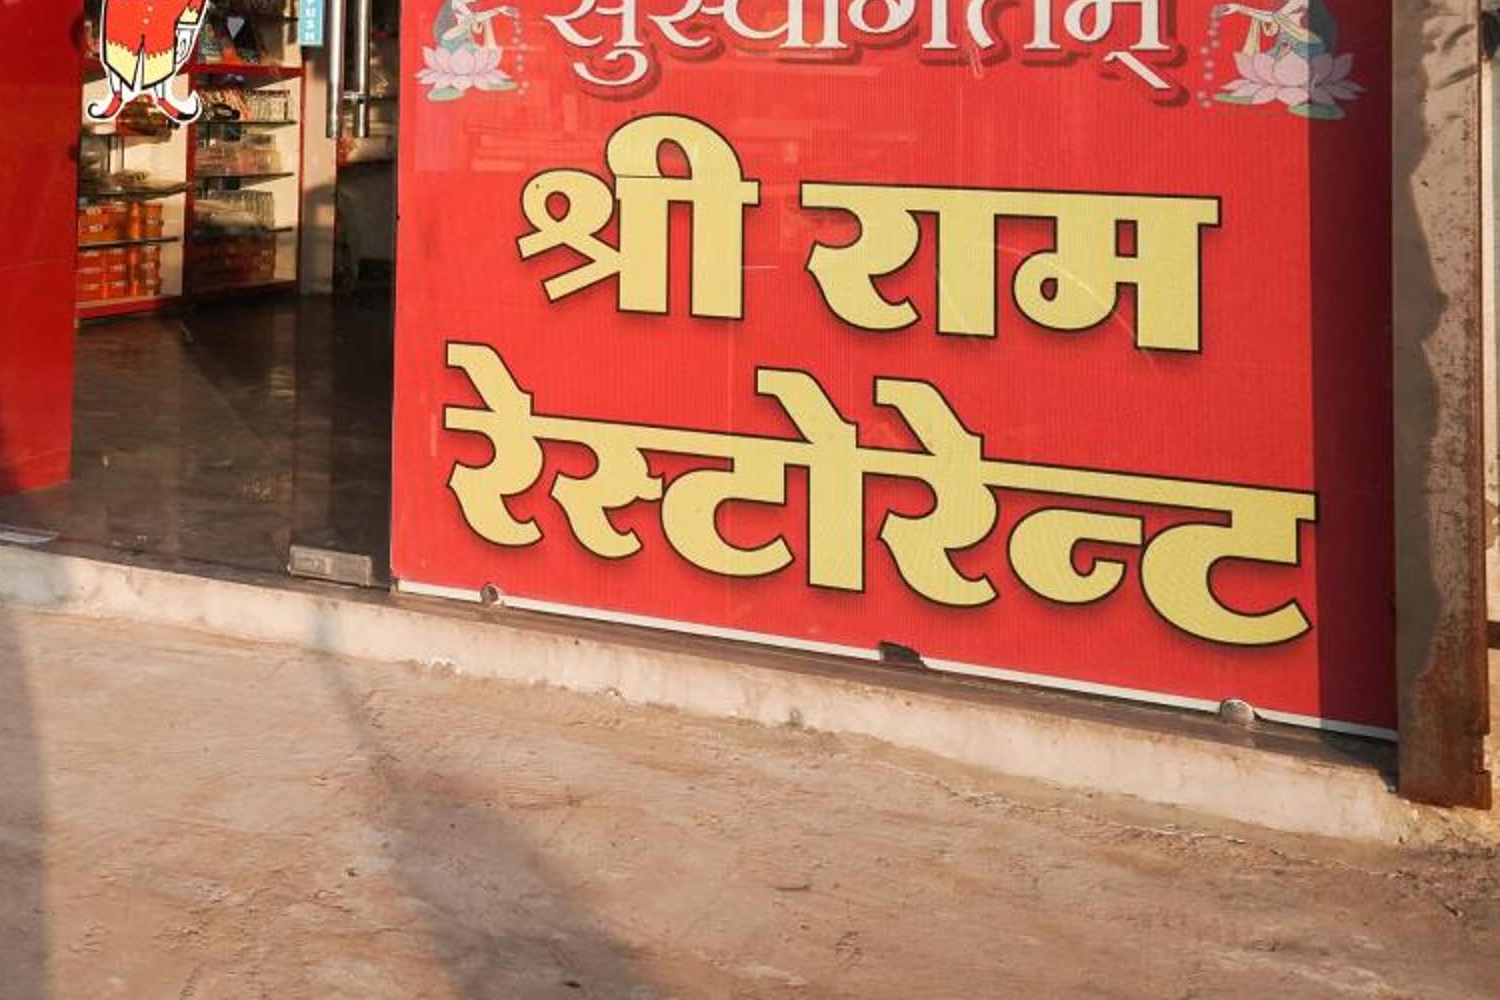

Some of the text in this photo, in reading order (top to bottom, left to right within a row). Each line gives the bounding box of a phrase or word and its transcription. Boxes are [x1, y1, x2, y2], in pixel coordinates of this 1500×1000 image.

[518, 113, 1221, 353] श्री राम
[443, 342, 1318, 646] रेस्टोरेन्ट
